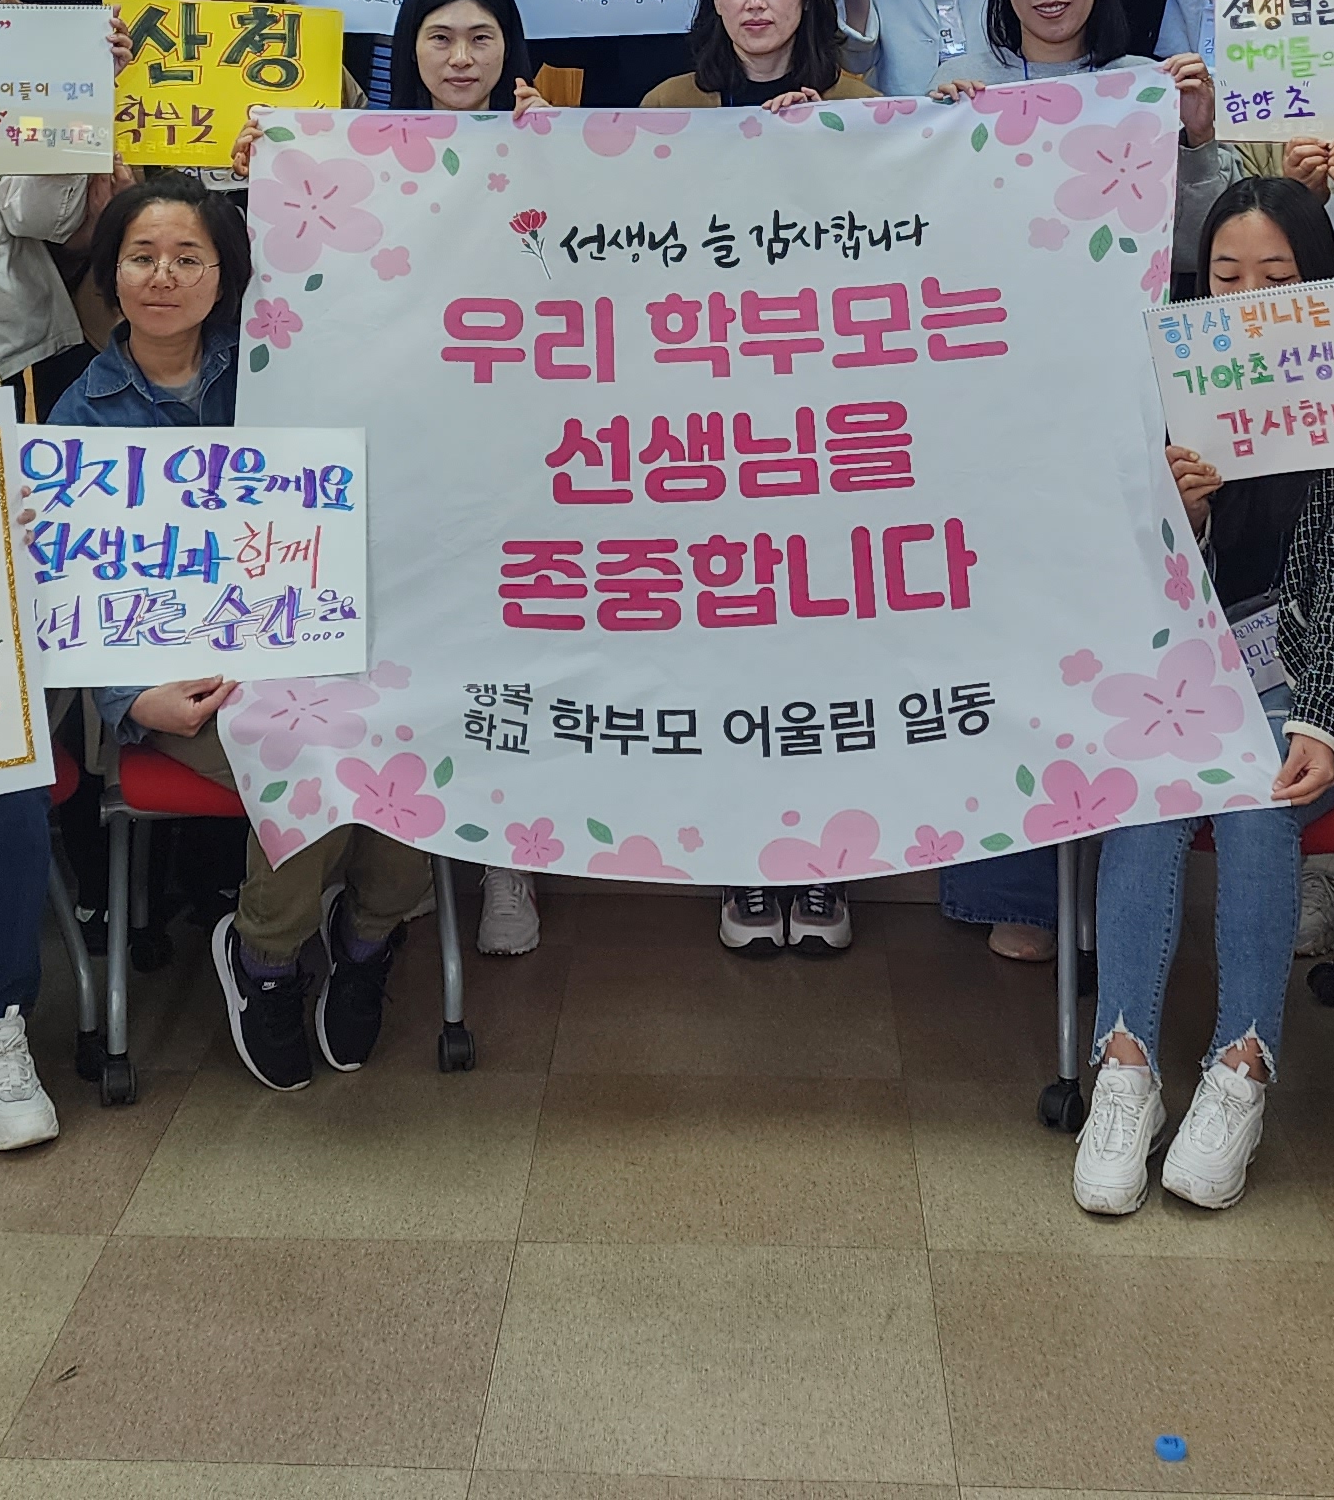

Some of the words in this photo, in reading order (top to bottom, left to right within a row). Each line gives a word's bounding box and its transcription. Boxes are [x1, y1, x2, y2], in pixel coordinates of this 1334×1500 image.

[126, 2, 304, 92] 산청
[115, 94, 217, 146] 학부모
[561, 214, 682, 264] 선생님
[702, 214, 741, 269] 늘
[749, 211, 930, 265] 감사합니다
[441, 296, 616, 384] 우리
[645, 276, 1009, 380] 학부모는
[1159, 308, 1231, 358] 항상
[1239, 295, 1331, 339] 빛나는
[1173, 352, 1275, 396] 가야초
[19, 439, 147, 514] 잊지
[545, 400, 916, 507] 선생님을
[27, 520, 233, 584] 선생님과
[233, 521, 322, 590] 함께
[497, 517, 978, 633] 존중합니다
[98, 587, 188, 647] 모든
[463, 683, 533, 715] 행복
[464, 709, 530, 754] 학교
[548, 698, 703, 760] 학부모
[722, 695, 877, 758] 어울림
[898, 680, 997, 744] 일동
